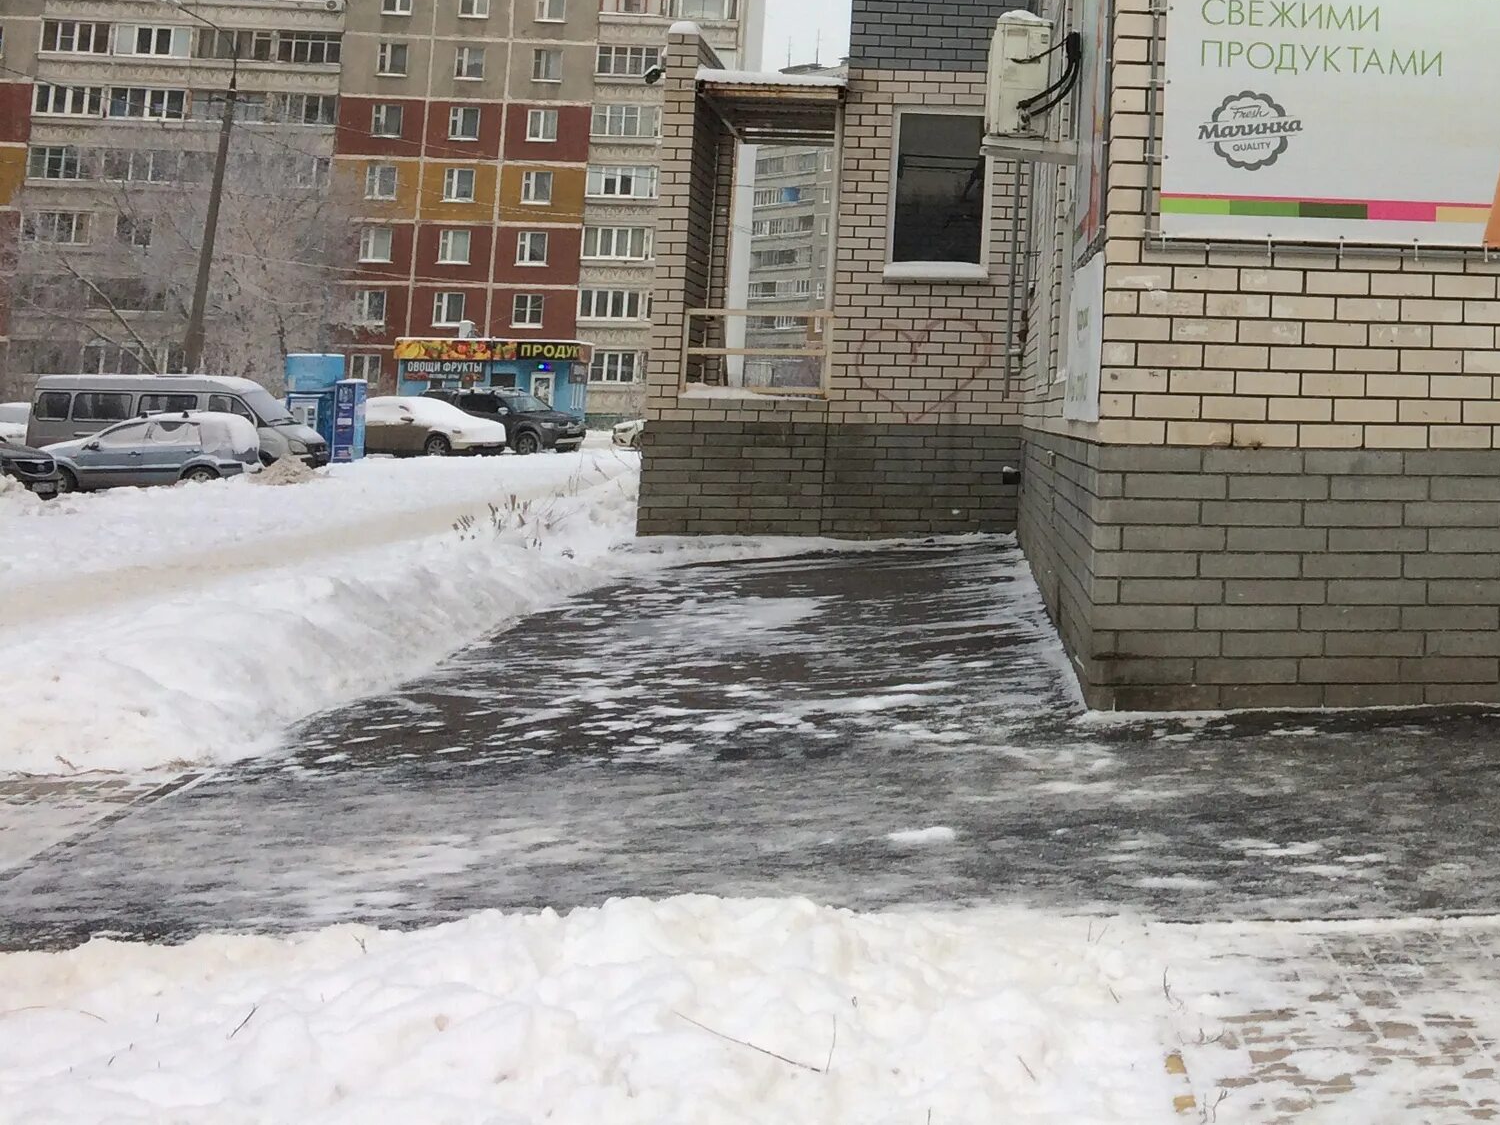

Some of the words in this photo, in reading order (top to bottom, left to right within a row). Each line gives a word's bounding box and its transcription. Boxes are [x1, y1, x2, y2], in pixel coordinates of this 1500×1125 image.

[1199, 39, 1444, 77] ПРОДУКТАМИ
[1230, 104, 1269, 119] Fresh
[1198, 120, 1304, 140] Малинка
[1232, 141, 1271, 152] QUALITY
[407, 361, 441, 372] ОВОЩИ
[442, 361, 483, 373] ФРУКТЫ
